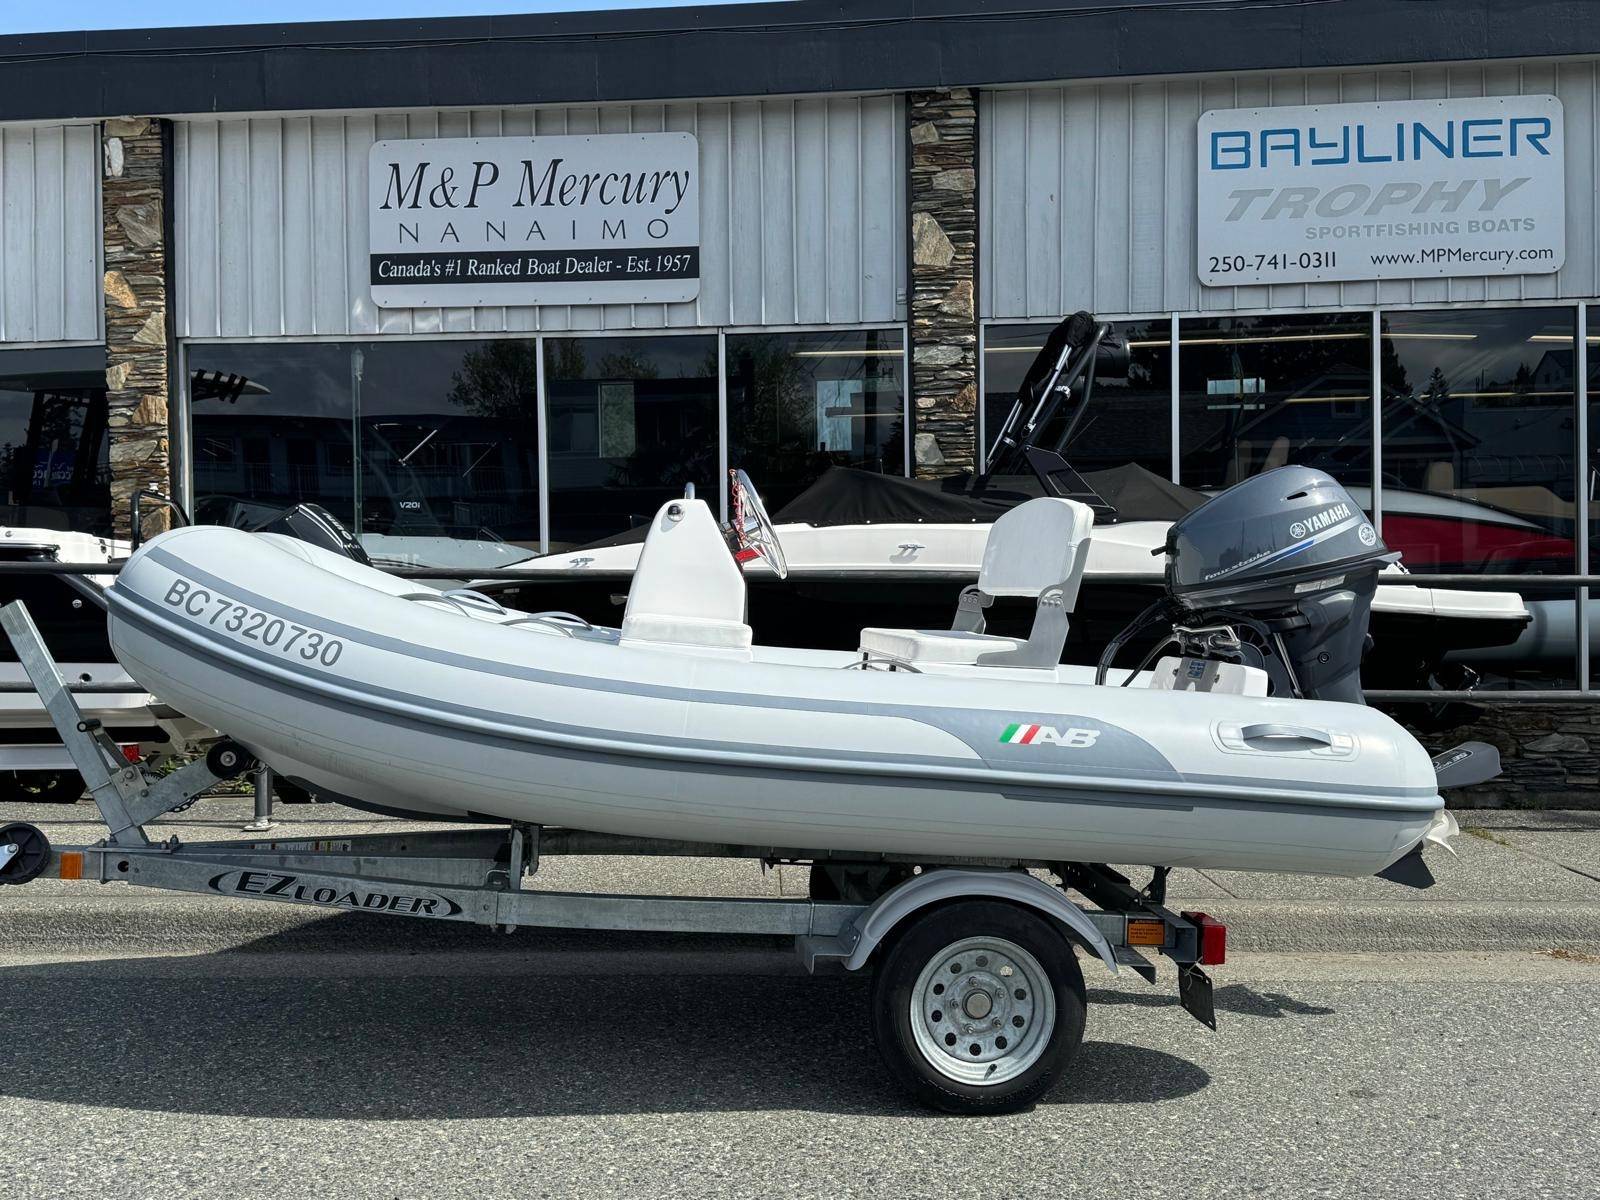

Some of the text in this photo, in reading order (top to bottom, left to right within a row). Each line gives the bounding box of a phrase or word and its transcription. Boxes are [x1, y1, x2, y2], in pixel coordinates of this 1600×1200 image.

[1210, 117, 1552, 170] BAYLINER
[379, 158, 690, 215] M&P Mercury
[1224, 177, 1533, 222] TROPHY
[399, 218, 669, 244] NANAIMO
[1305, 217, 1536, 240] SPORTFISHING BOATS
[378, 258, 441, 278] Canada's
[445, 258, 462, 277] #1
[467, 257, 522, 276] Ranked
[527, 257, 561, 276] Boat
[565, 256, 613, 275] Dealer
[626, 255, 652, 273] Est.
[656, 254, 691, 272] 1957
[1209, 251, 1337, 273] 250-741-0311
[1370, 246, 1554, 266] www.MPMercury.com
[399, 501, 421, 509] V20i
[1303, 503, 1352, 533] YAMAHA
[1029, 725, 1101, 748] AB
